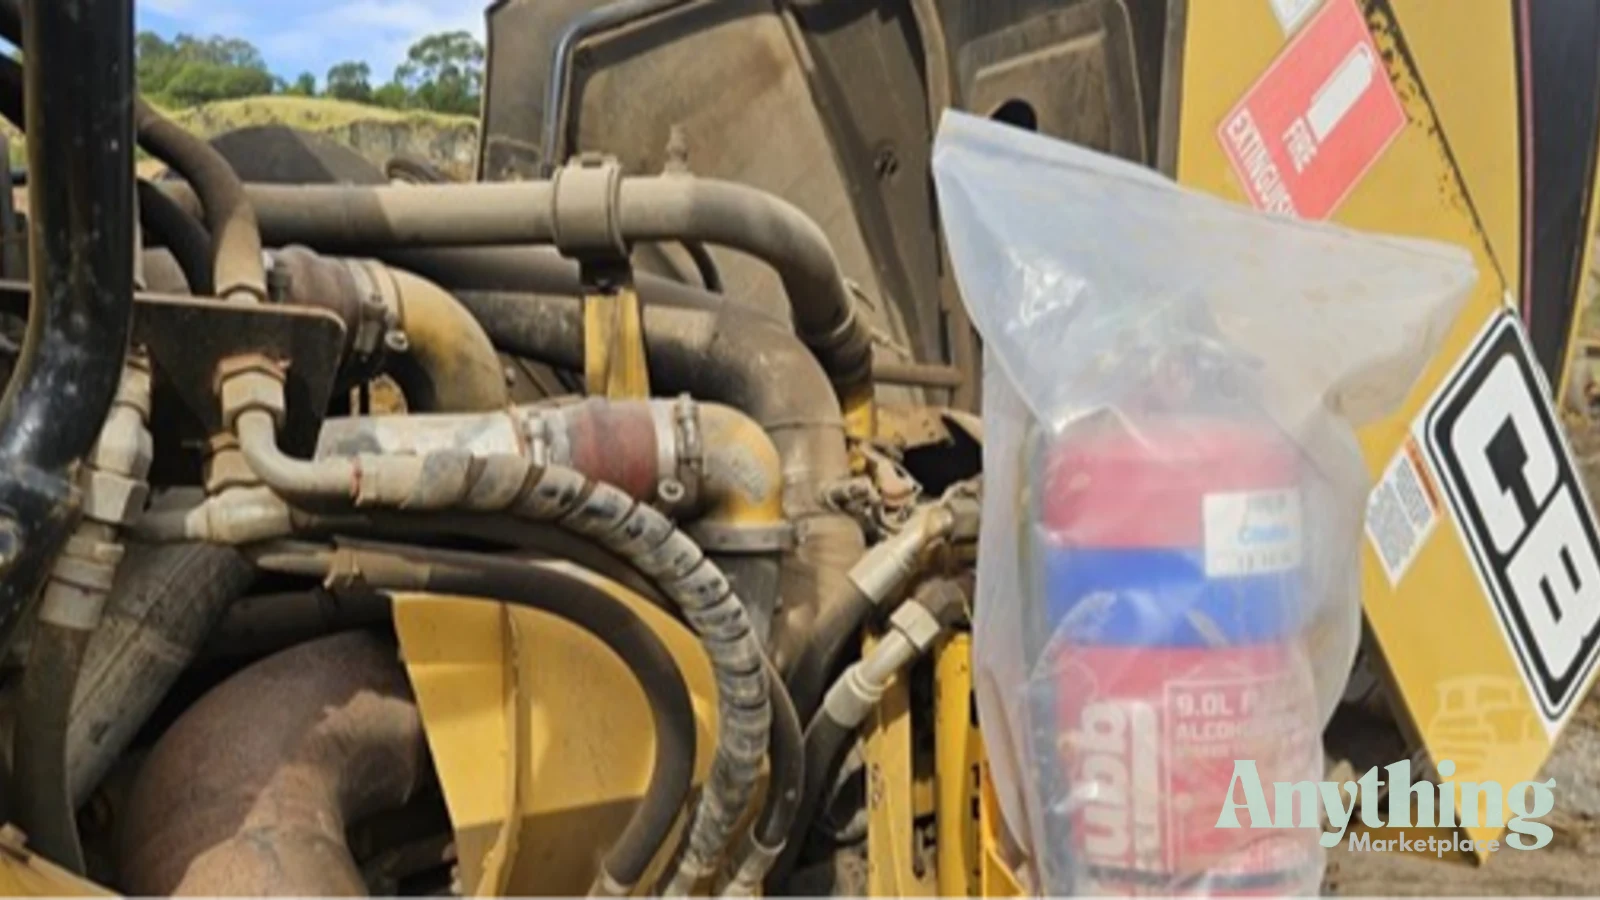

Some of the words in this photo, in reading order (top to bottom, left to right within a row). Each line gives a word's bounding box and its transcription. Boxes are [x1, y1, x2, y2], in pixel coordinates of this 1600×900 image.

[1226, 106, 1298, 214] EXTINGUIS
[1280, 114, 1318, 175] FIRE
[1451, 352, 1600, 681] CB
